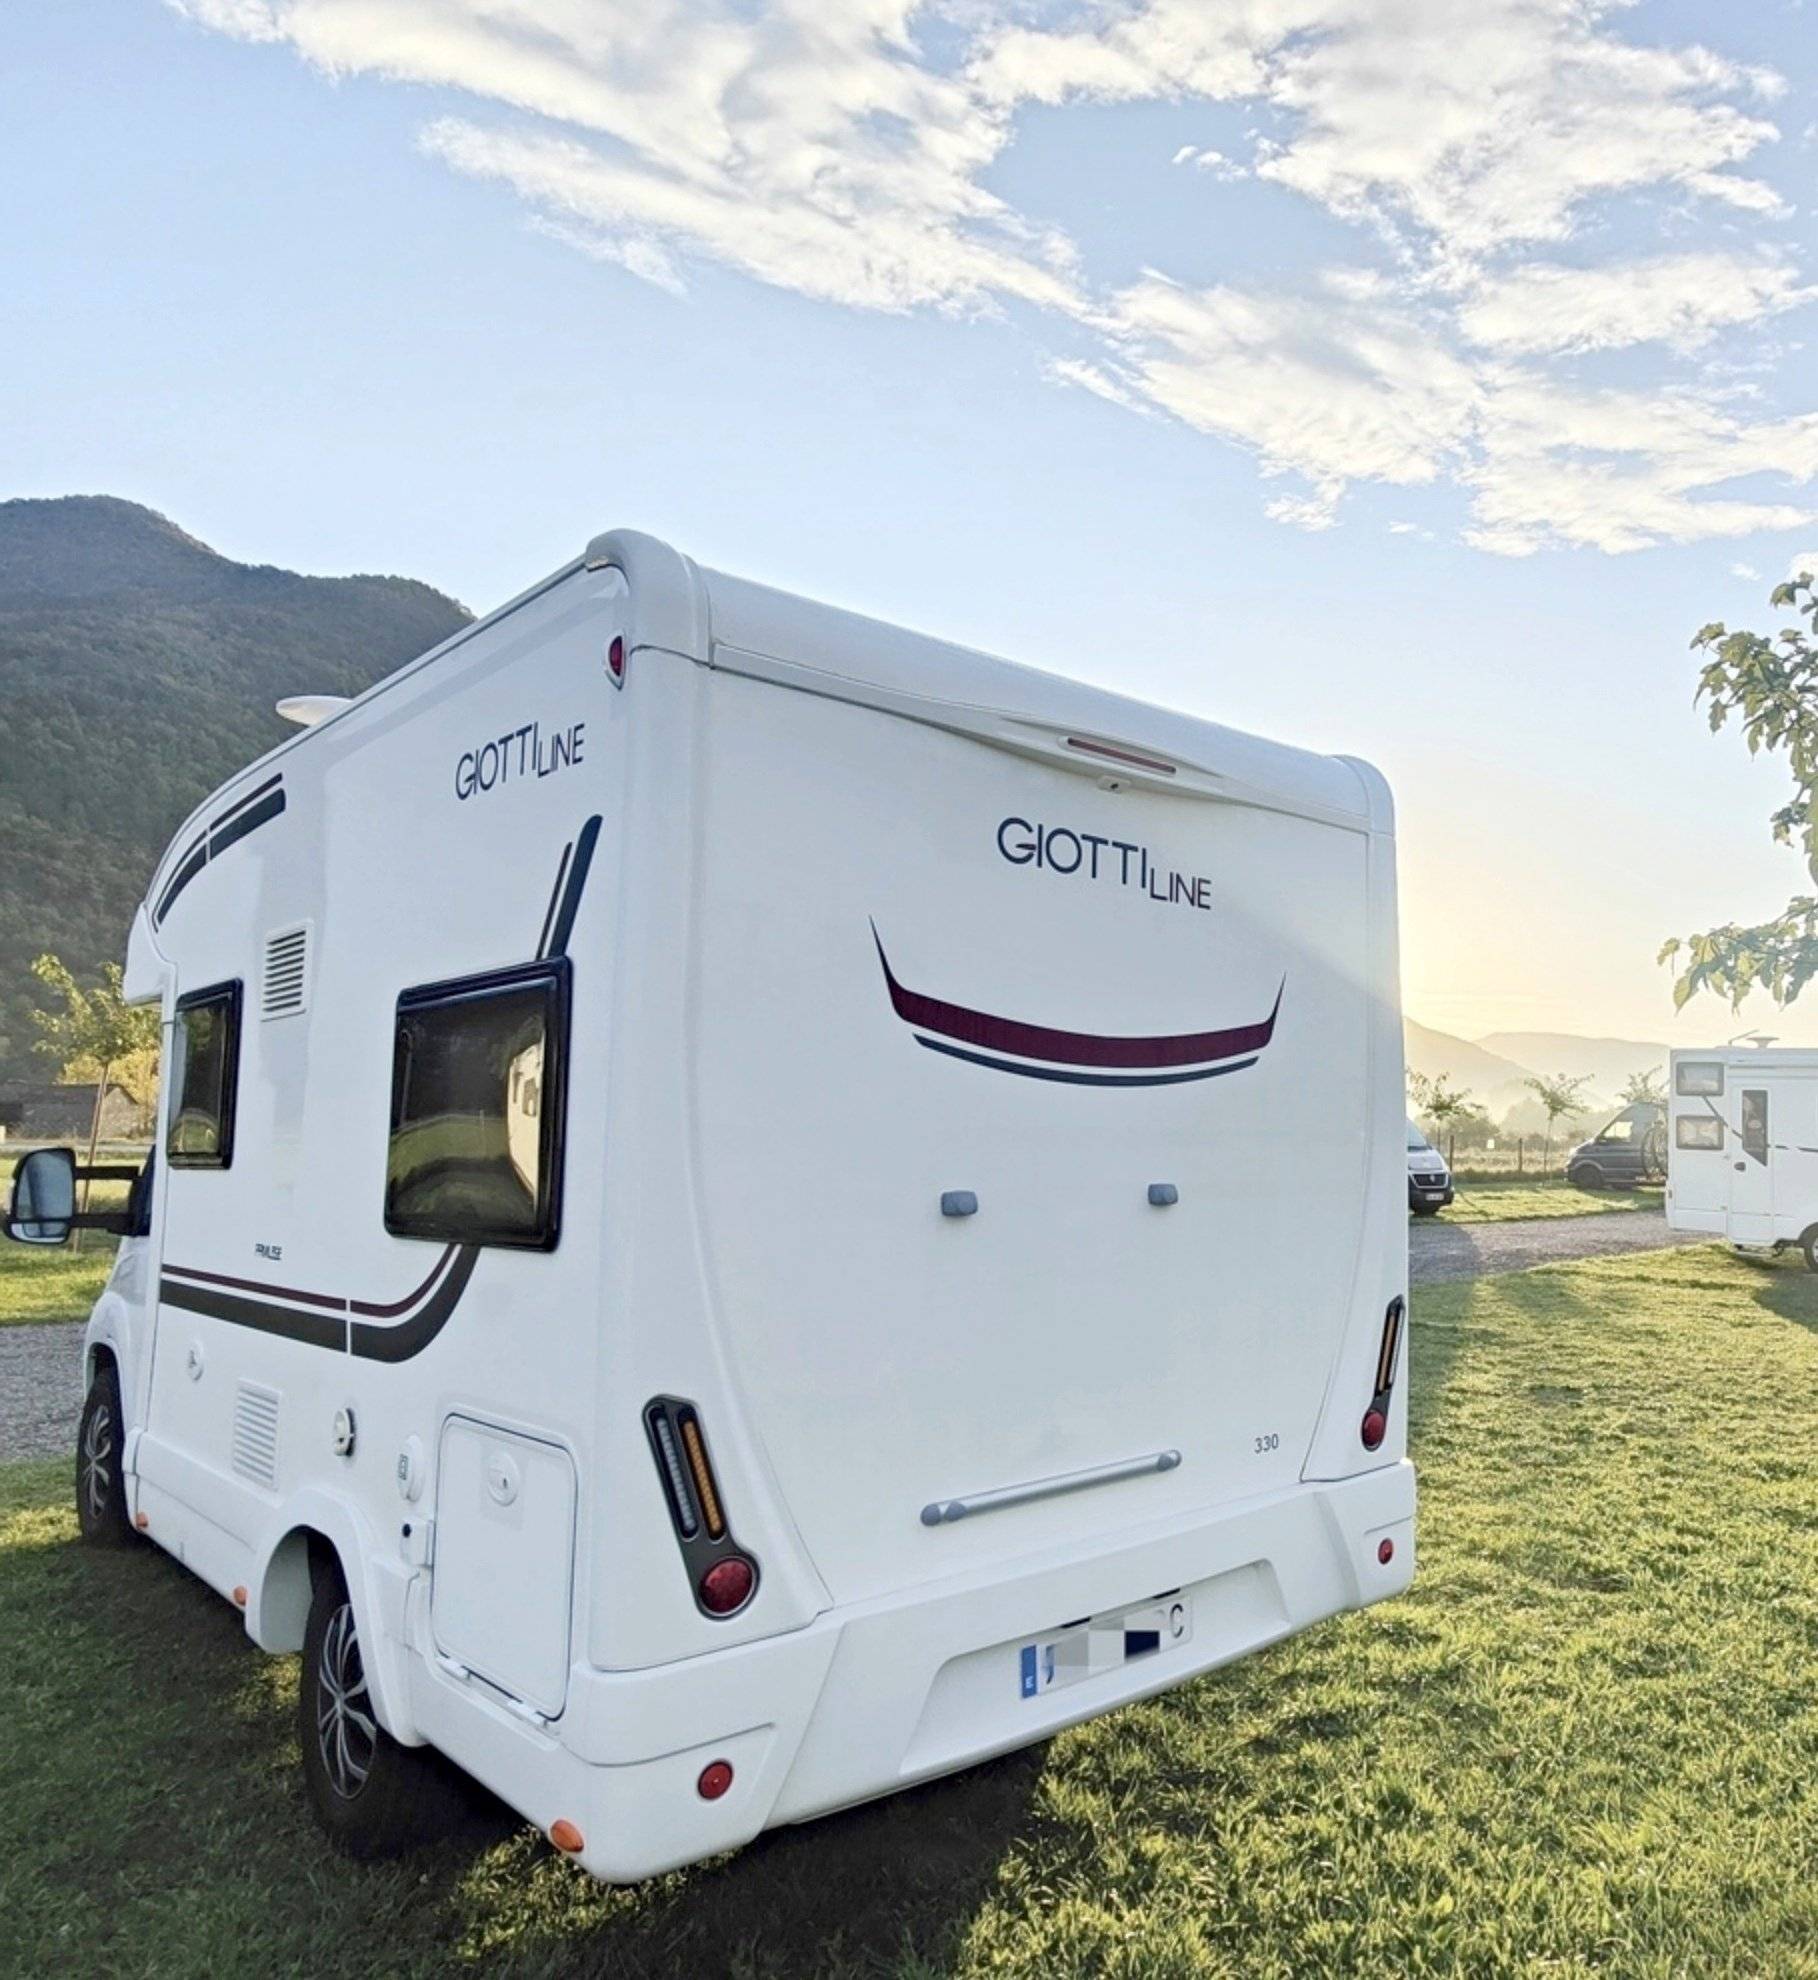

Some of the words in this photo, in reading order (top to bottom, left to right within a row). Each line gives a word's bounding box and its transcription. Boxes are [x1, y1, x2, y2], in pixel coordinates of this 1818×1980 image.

[455, 721, 585, 801] GIOTTILINE
[997, 817, 1212, 911] GIOTTILINE
[1254, 1433, 1279, 1454] 330
